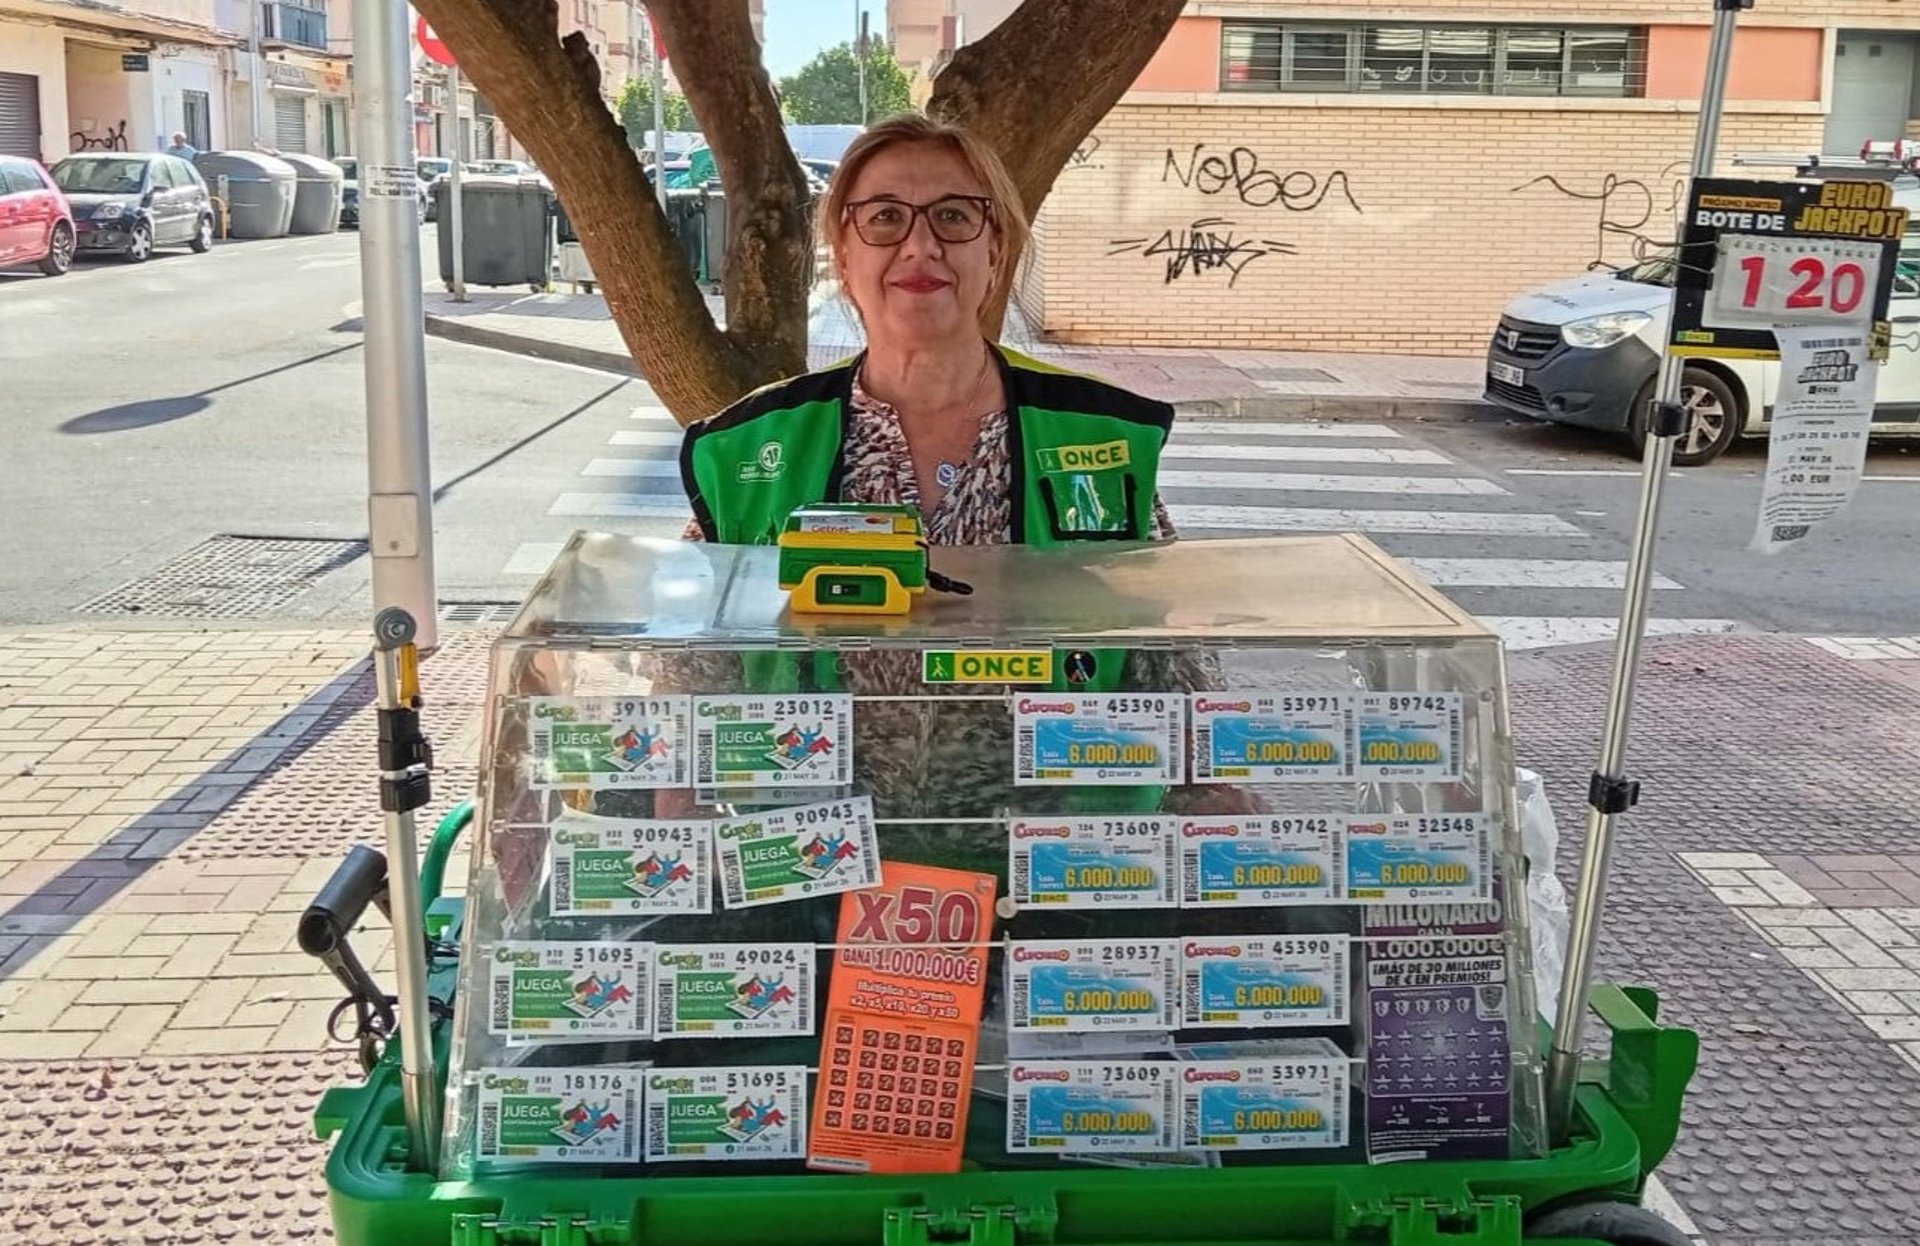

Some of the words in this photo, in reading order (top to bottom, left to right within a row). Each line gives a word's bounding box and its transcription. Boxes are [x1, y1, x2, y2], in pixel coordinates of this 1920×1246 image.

[1821, 182, 1885, 207] EURO
[1696, 211, 1753, 229] BOTE
[1757, 214, 1785, 231] DE
[1794, 207, 1902, 236] JACKPOT
[1064, 445, 1124, 466] ONCE
[961, 656, 1044, 677] ONCE
[612, 702, 671, 716] 39101
[775, 701, 834, 715] 23012
[1107, 699, 1165, 713] 45390
[1283, 697, 1339, 711] 53971
[1389, 697, 1445, 711] 89742
[554, 733, 602, 745] JUEGA
[719, 731, 765, 743] JUEGA
[1069, 744, 1155, 764] 6.000.000
[1247, 742, 1331, 762] 6.000.000
[1363, 742, 1438, 761] .000.000
[795, 804, 853, 825] 90943
[1103, 822, 1161, 836] 73609
[1271, 819, 1328, 834] 89742
[1419, 818, 1474, 832] 32548
[633, 827, 692, 842] 90943
[743, 845, 789, 863] JUEGA
[576, 859, 623, 871] JUEGA
[1065, 868, 1152, 888] 6.000.000
[1234, 865, 1319, 886] 6.000.000
[1382, 864, 1465, 884] 6.000.000
[1367, 901, 1502, 927] MILLONARIO
[1102, 946, 1161, 960] 28937
[1273, 940, 1330, 954] 45390
[573, 948, 633, 962] 51695
[735, 949, 796, 964] 49024
[843, 948, 872, 964] GANA
[874, 949, 979, 983] 1.000.000€
[1408, 963, 1424, 974] DE
[1445, 959, 1502, 972] MILLONES
[515, 979, 563, 990] JUEGA
[1386, 975, 1401, 986] DE
[1414, 974, 1431, 985] EN
[1435, 971, 1492, 983] PREMIOS!
[678, 981, 726, 993] JUEGA
[920, 991, 956, 1003] premio
[1064, 992, 1150, 1011] 6.000.000
[1236, 986, 1320, 1006] 6.000.000
[727, 1072, 786, 1087] 51695
[1102, 1067, 1160, 1081] 73609
[1272, 1066, 1329, 1079] 53971
[564, 1075, 622, 1090] 18176
[503, 1105, 550, 1117] JUEGA
[670, 1104, 717, 1116] JUEGA
[1063, 1113, 1149, 1132] 6.000.000
[1234, 1110, 1319, 1130] 6.000.000
